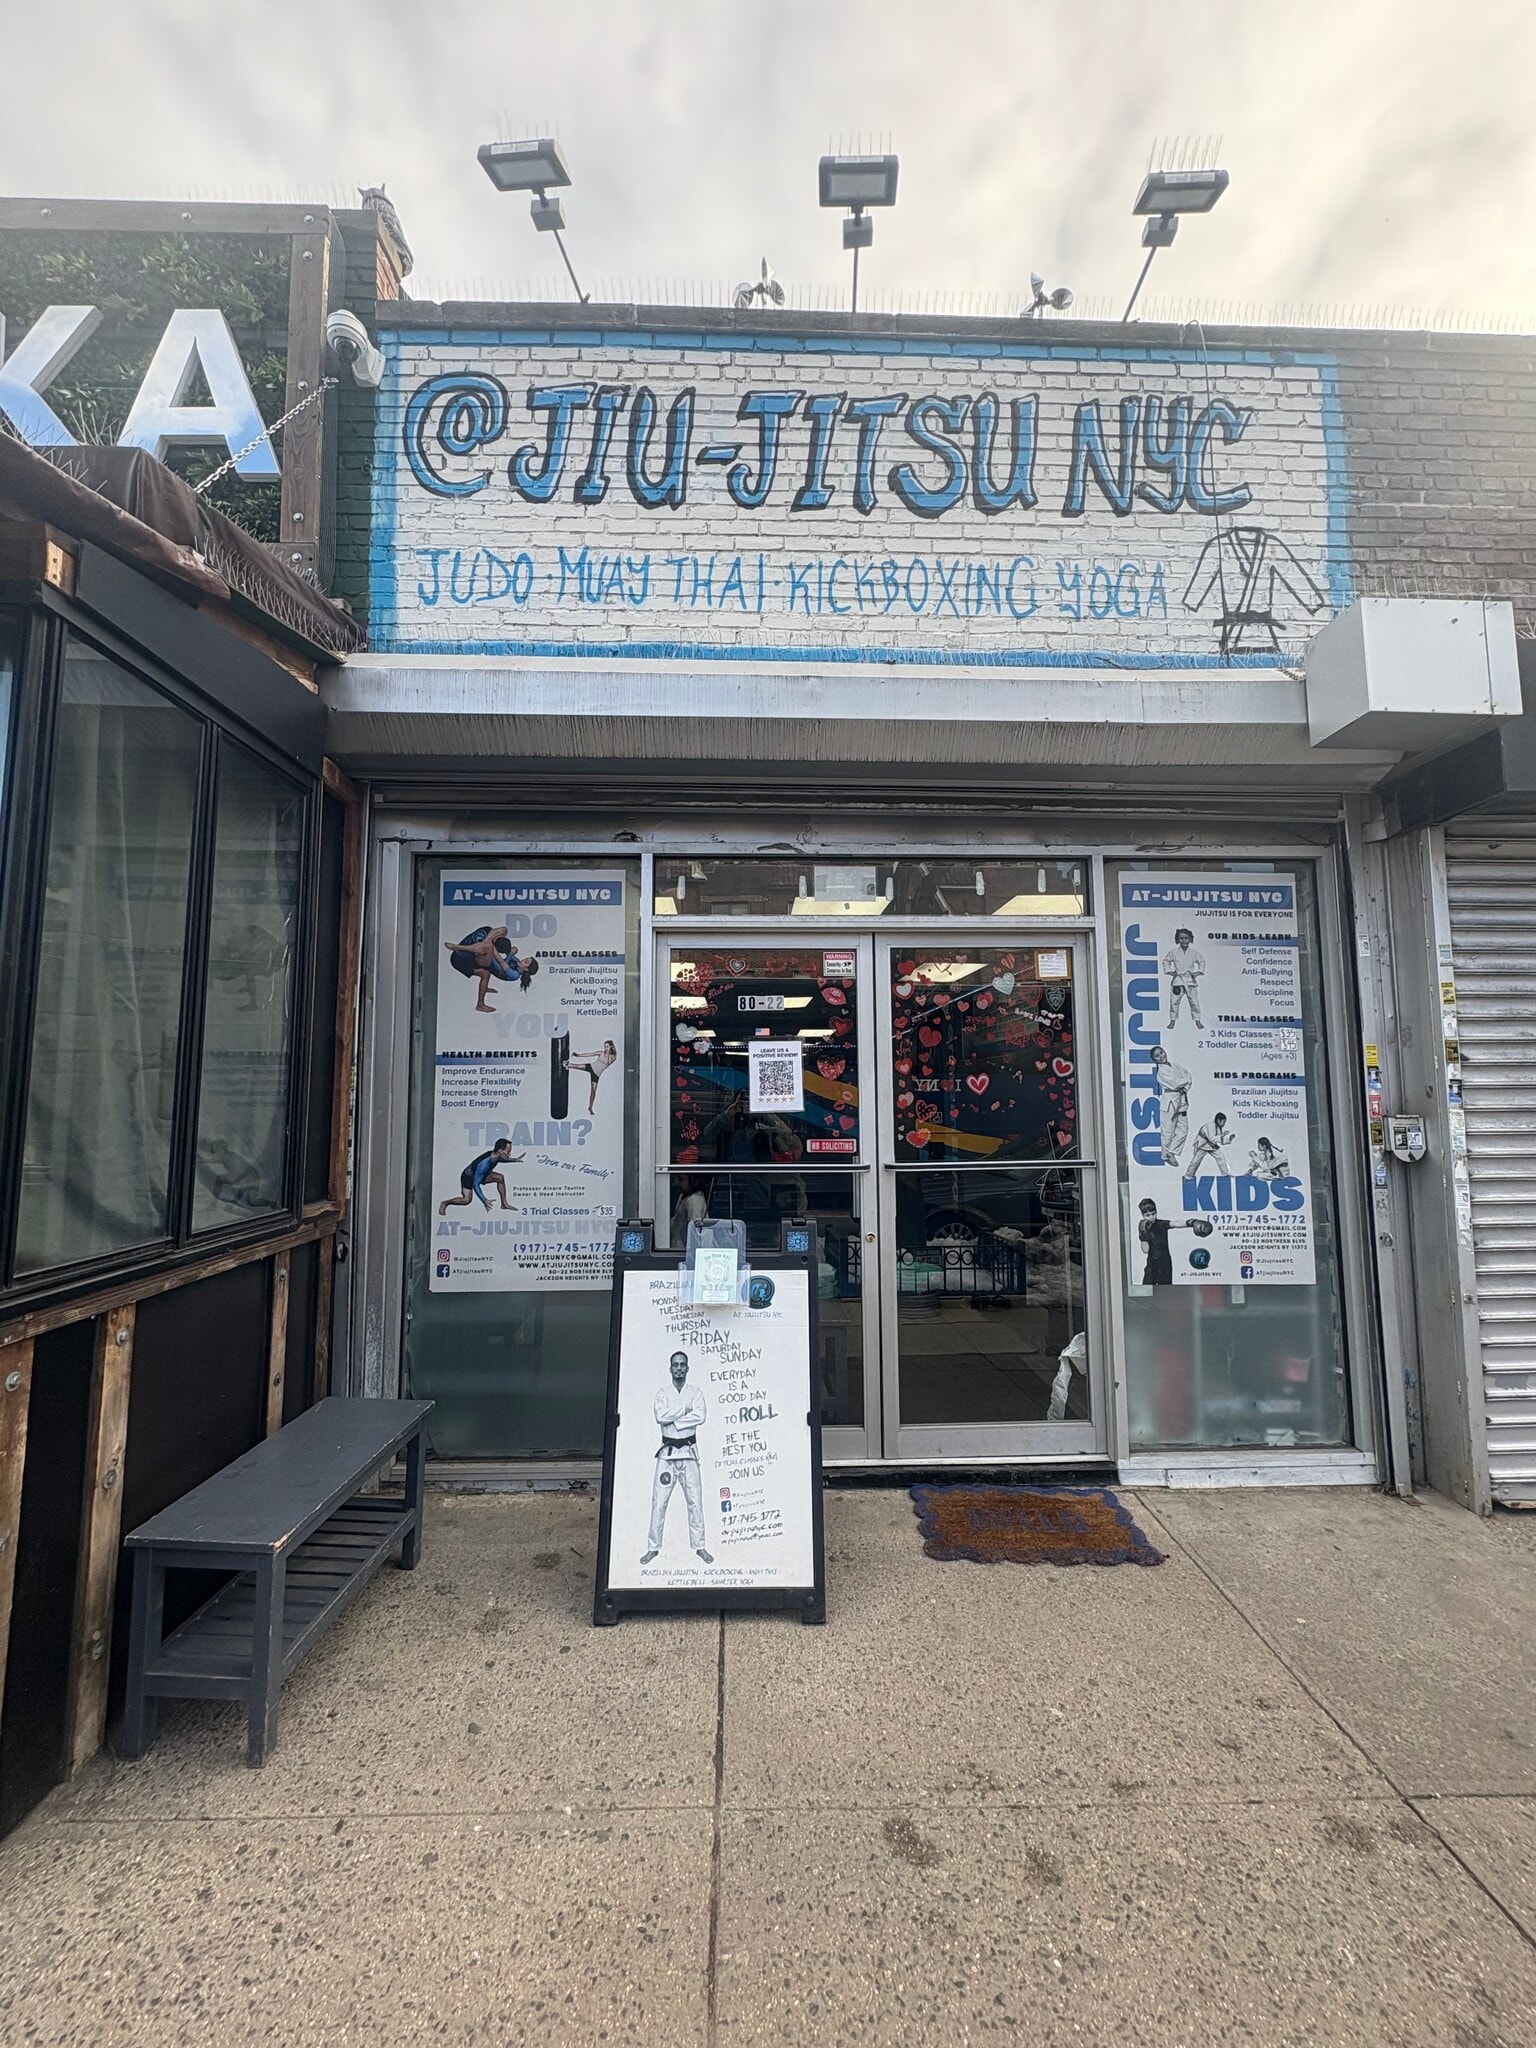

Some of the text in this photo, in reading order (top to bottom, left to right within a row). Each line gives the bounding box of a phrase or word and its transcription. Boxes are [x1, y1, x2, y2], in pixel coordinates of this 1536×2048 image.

[1062, 395, 1253, 517] NYC
[416, 546, 1167, 620] JUDO MUAY THAI KICKBOXING YOGA
[453, 889, 612, 901] AT-JIUJITSU NYC
[1131, 890, 1283, 903] AT-JIUJITSU NYC
[505, 914, 557, 938] DO
[1259, 933, 1292, 941] LEARN
[1241, 947, 1257, 955] Self
[1246, 957, 1293, 966] Confidence
[549, 966, 618, 975] Brazilian Jiujitsu
[1241, 967, 1293, 977] Anti-Bullying
[569, 977, 618, 985] KickBoxing
[1260, 978, 1294, 987] Respect
[574, 987, 618, 996] Muay Thai
[1254, 988, 1294, 998] Discipline
[560, 998, 618, 1007] Smarter Yoga
[739, 996, 783, 1010] 80-22
[1269, 999, 1295, 1007] Focus
[576, 1008, 618, 1016] KettleBell
[1250, 1015, 1295, 1023] CLASSES
[492, 1013, 569, 1038] YOU
[1218, 1029, 1237, 1038] Kids
[1239, 1030, 1273, 1038] Classes
[1205, 1040, 1237, 1049] Toddler
[1240, 1041, 1273, 1049] Classes
[1260, 1052, 1298, 1061] (Ages +3)
[442, 1067, 526, 1076] Improve Endurance
[1241, 1072, 1297, 1080] PROGRAMS
[442, 1078, 522, 1087] Increase Flexibility
[441, 1088, 518, 1097] Increase Strength
[1231, 1088, 1298, 1097] Brazilian Jiujitsu
[469, 1100, 500, 1109] Energy
[1232, 1099, 1299, 1109] Kids Kickboxing
[1237, 1111, 1300, 1121] Toddler Jiujitsu
[464, 1119, 592, 1146] TRAIN?
[811, 1141, 853, 1150] NO SOLICITING
[561, 1162, 576, 1171] our
[1182, 1175, 1305, 1212] KIDS
[521, 1207, 528, 1216] 3
[530, 1207, 550, 1216] Trial
[552, 1207, 590, 1216] Classes
[1207, 1214, 1306, 1224] (917)-745-1772
[436, 1219, 616, 1236] AT-JIUJITSU NYC
[652, 1296, 679, 1306] MONDA
[659, 1304, 695, 1315] TUESDAY
[670, 1311, 705, 1321] WEDNESDAY
[665, 1319, 712, 1333] THURSDAY
[680, 1330, 730, 1346] FRIDAY
[700, 1342, 742, 1355] SATURDAY
[720, 1348, 762, 1364] SUNDAY
[710, 1368, 757, 1382] EVERYDAY
[728, 1380, 749, 1391] IS A
[718, 1390, 767, 1404] GOOD DAY
[724, 1403, 779, 1425] TO ROLL
[725, 1430, 761, 1444] BE THE
[722, 1440, 767, 1457] BEST YOU
[728, 1464, 765, 1480] JOIN US
